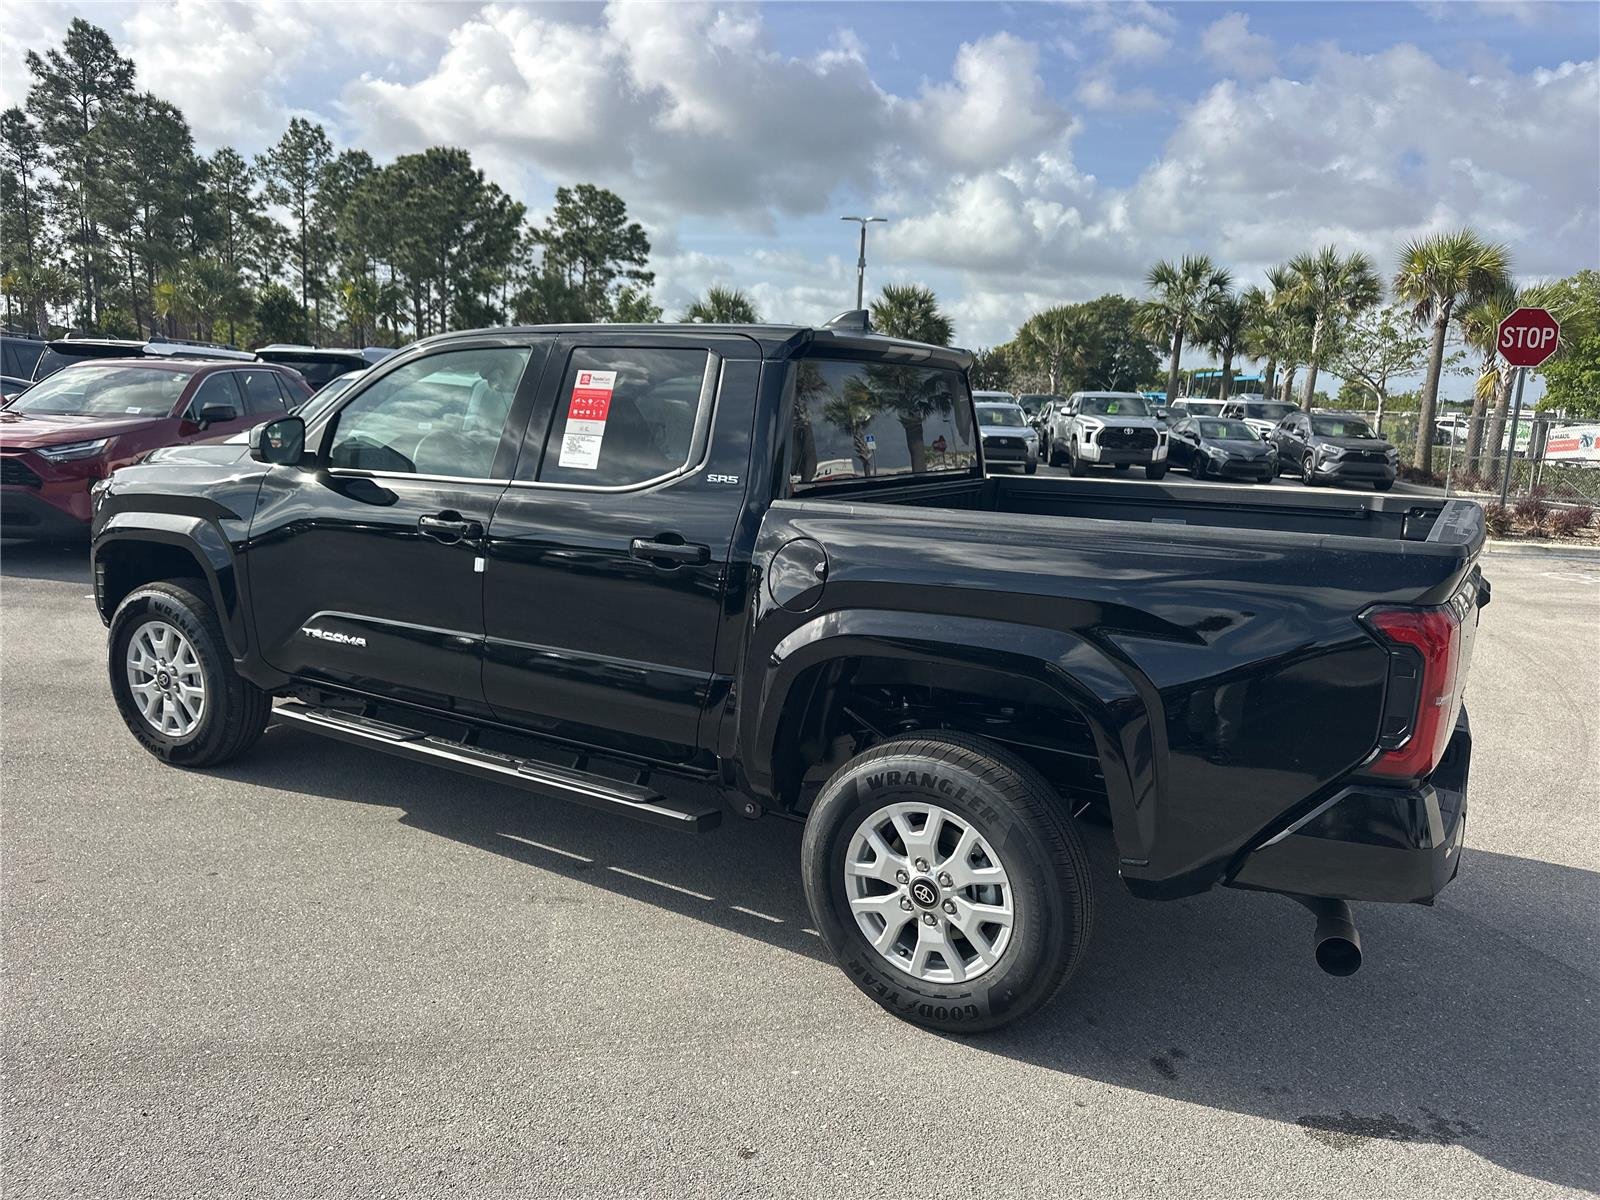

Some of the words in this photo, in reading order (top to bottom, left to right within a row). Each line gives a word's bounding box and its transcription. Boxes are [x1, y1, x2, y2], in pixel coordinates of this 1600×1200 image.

[1501, 326, 1555, 349] STOP
[706, 473, 739, 484] SR5
[302, 627, 367, 648] TACOMA
[866, 770, 1000, 825] WRANGLER
